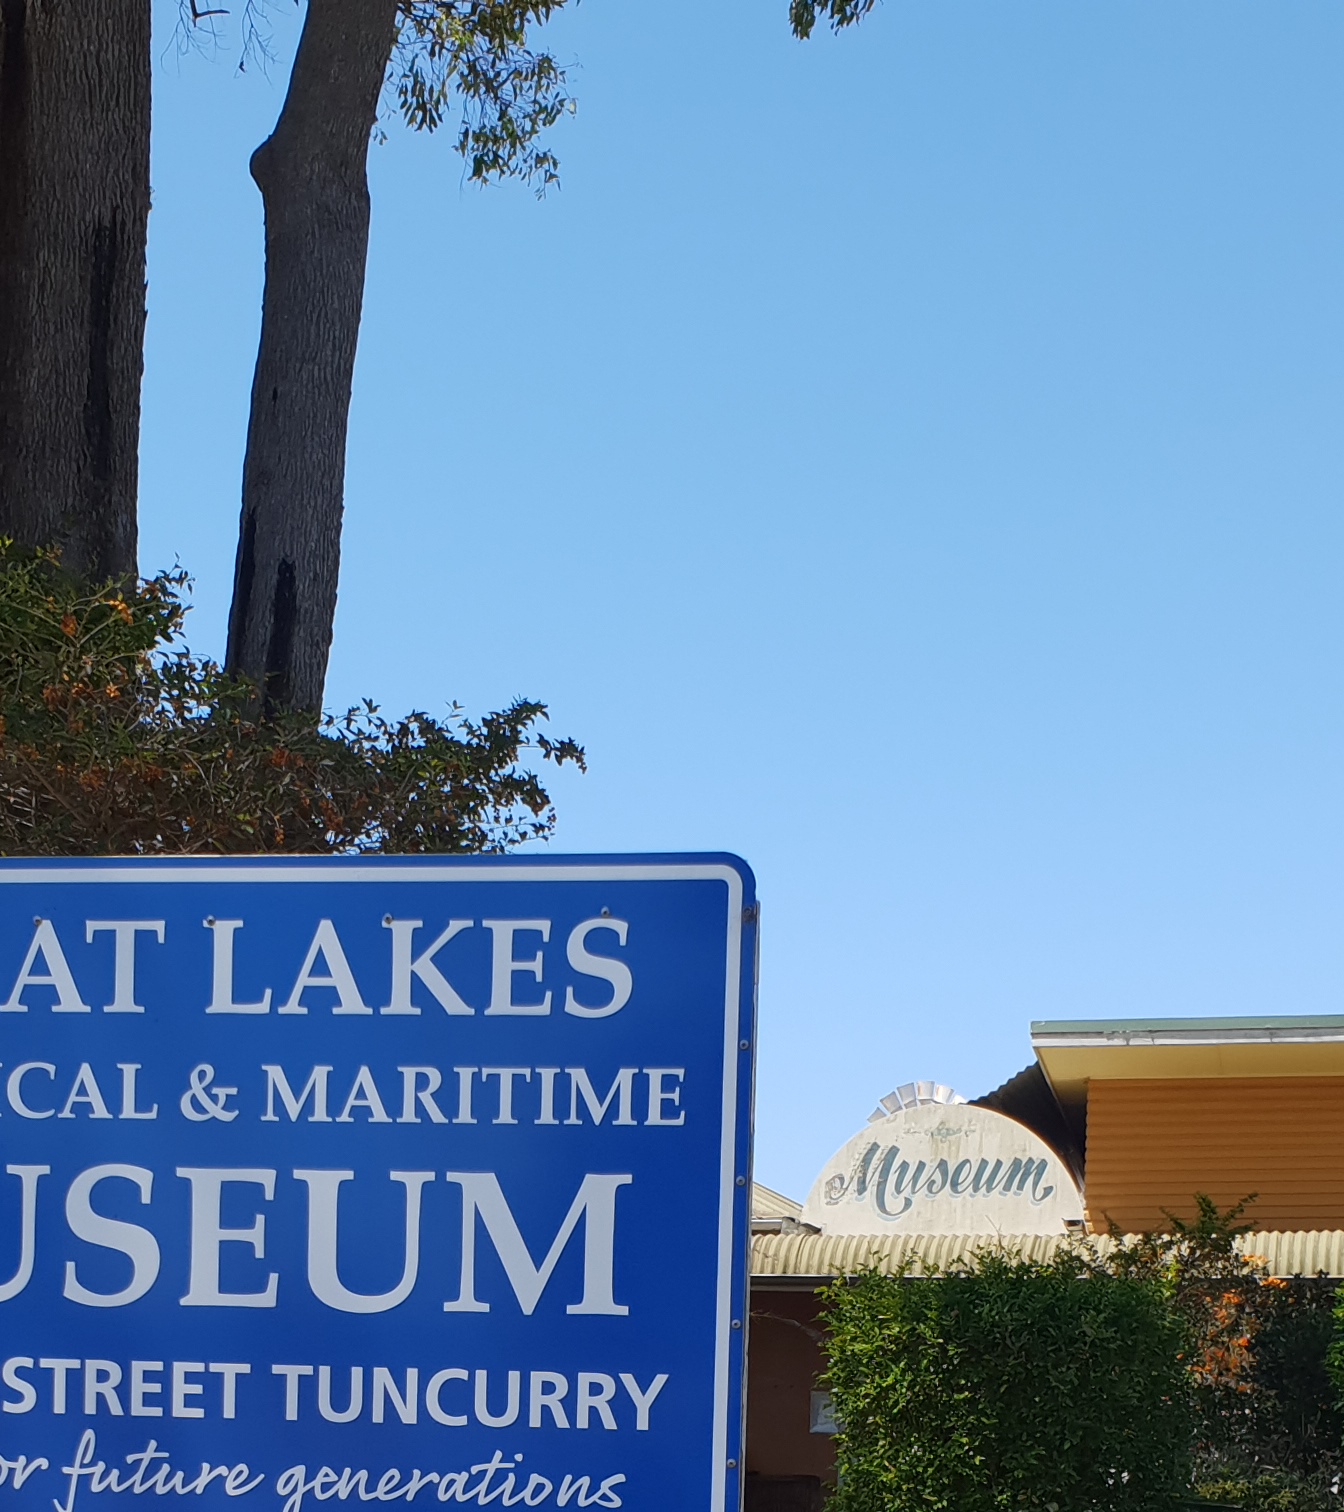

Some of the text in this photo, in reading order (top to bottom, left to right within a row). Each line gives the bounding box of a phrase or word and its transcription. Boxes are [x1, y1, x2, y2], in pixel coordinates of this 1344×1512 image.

[204, 914, 635, 1018] LAKES
[179, 1064, 239, 1123] &
[260, 1064, 687, 1127] MARITIME
[825, 1141, 1056, 1221] Museum
[1, 1356, 251, 1419] STREET
[271, 1364, 669, 1431] TUNCURRY
